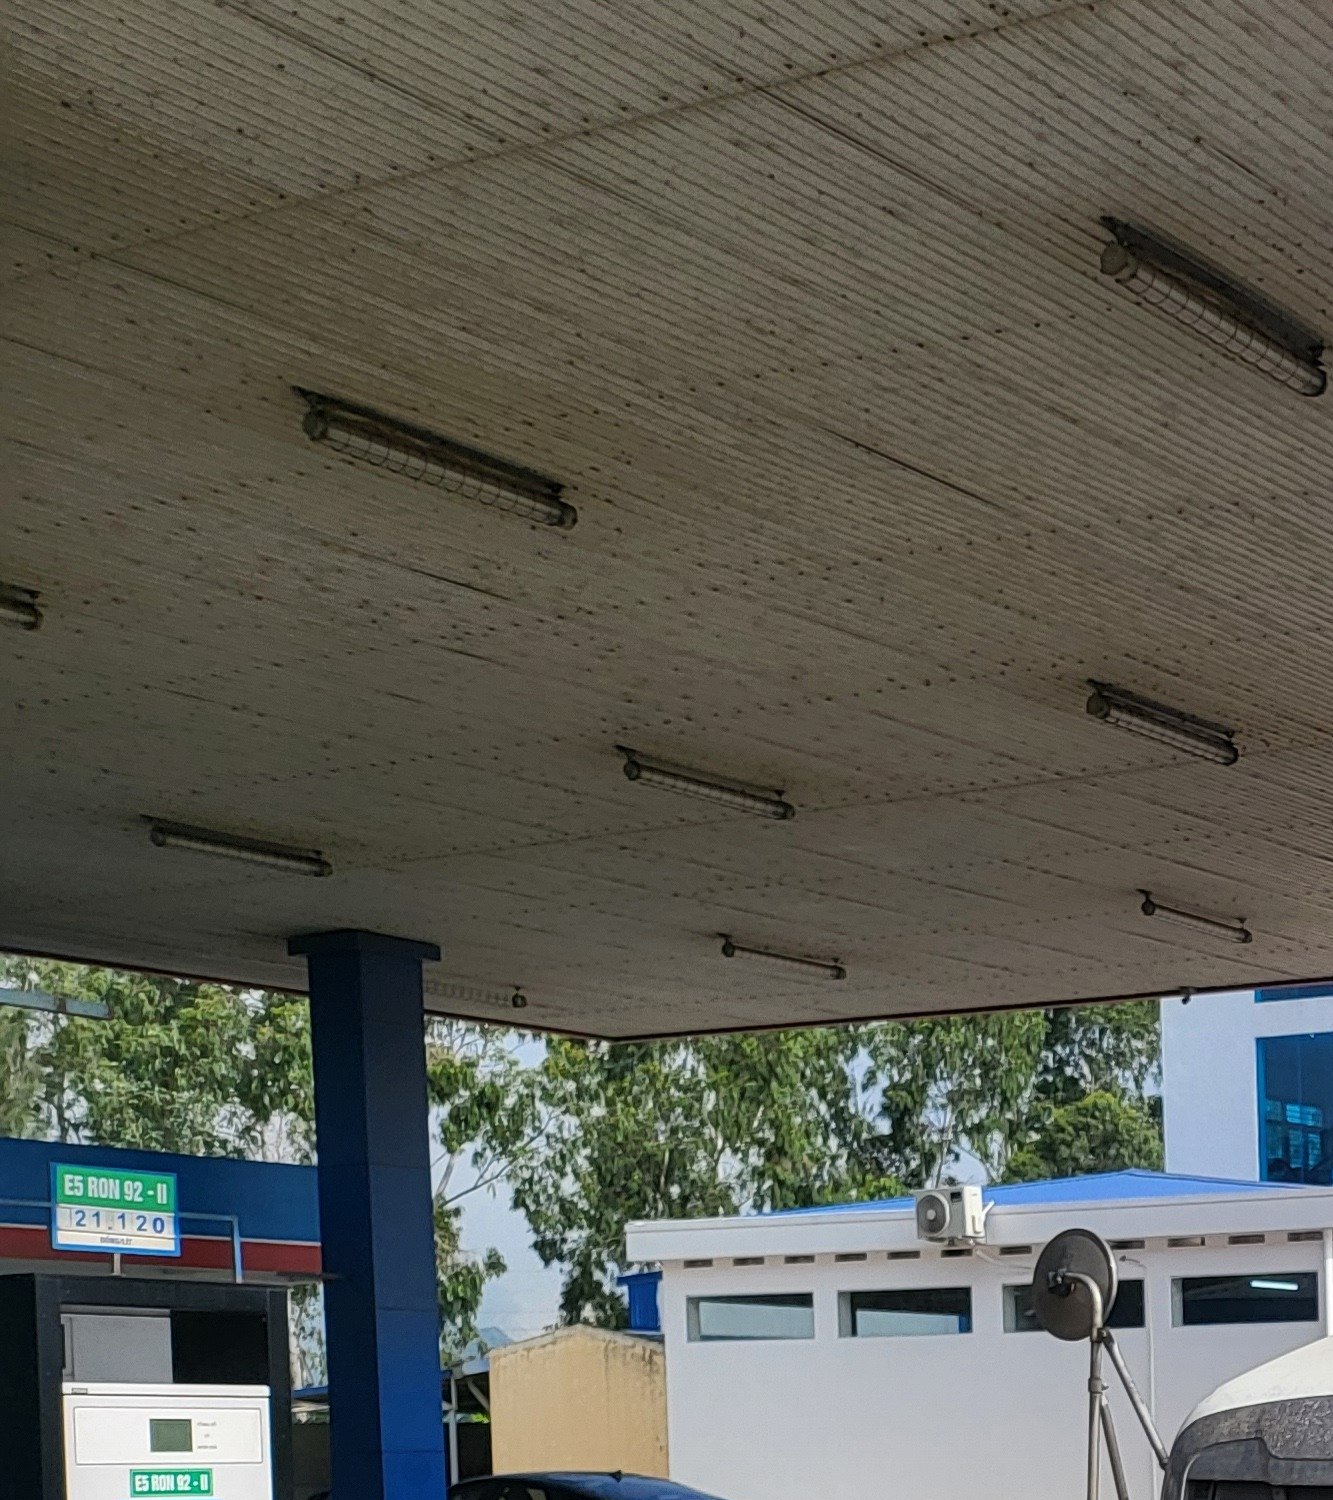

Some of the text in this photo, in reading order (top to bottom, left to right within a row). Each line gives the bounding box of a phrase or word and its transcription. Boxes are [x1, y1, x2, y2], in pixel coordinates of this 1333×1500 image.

[64, 1174, 84, 1196] E5
[88, 1176, 120, 1200] RON
[124, 1180, 143, 1202] 92
[75, 1210, 165, 1233] 21.120
[135, 1474, 149, 1491] E5
[151, 1474, 175, 1491] RON
[177, 1474, 191, 1491] 92
